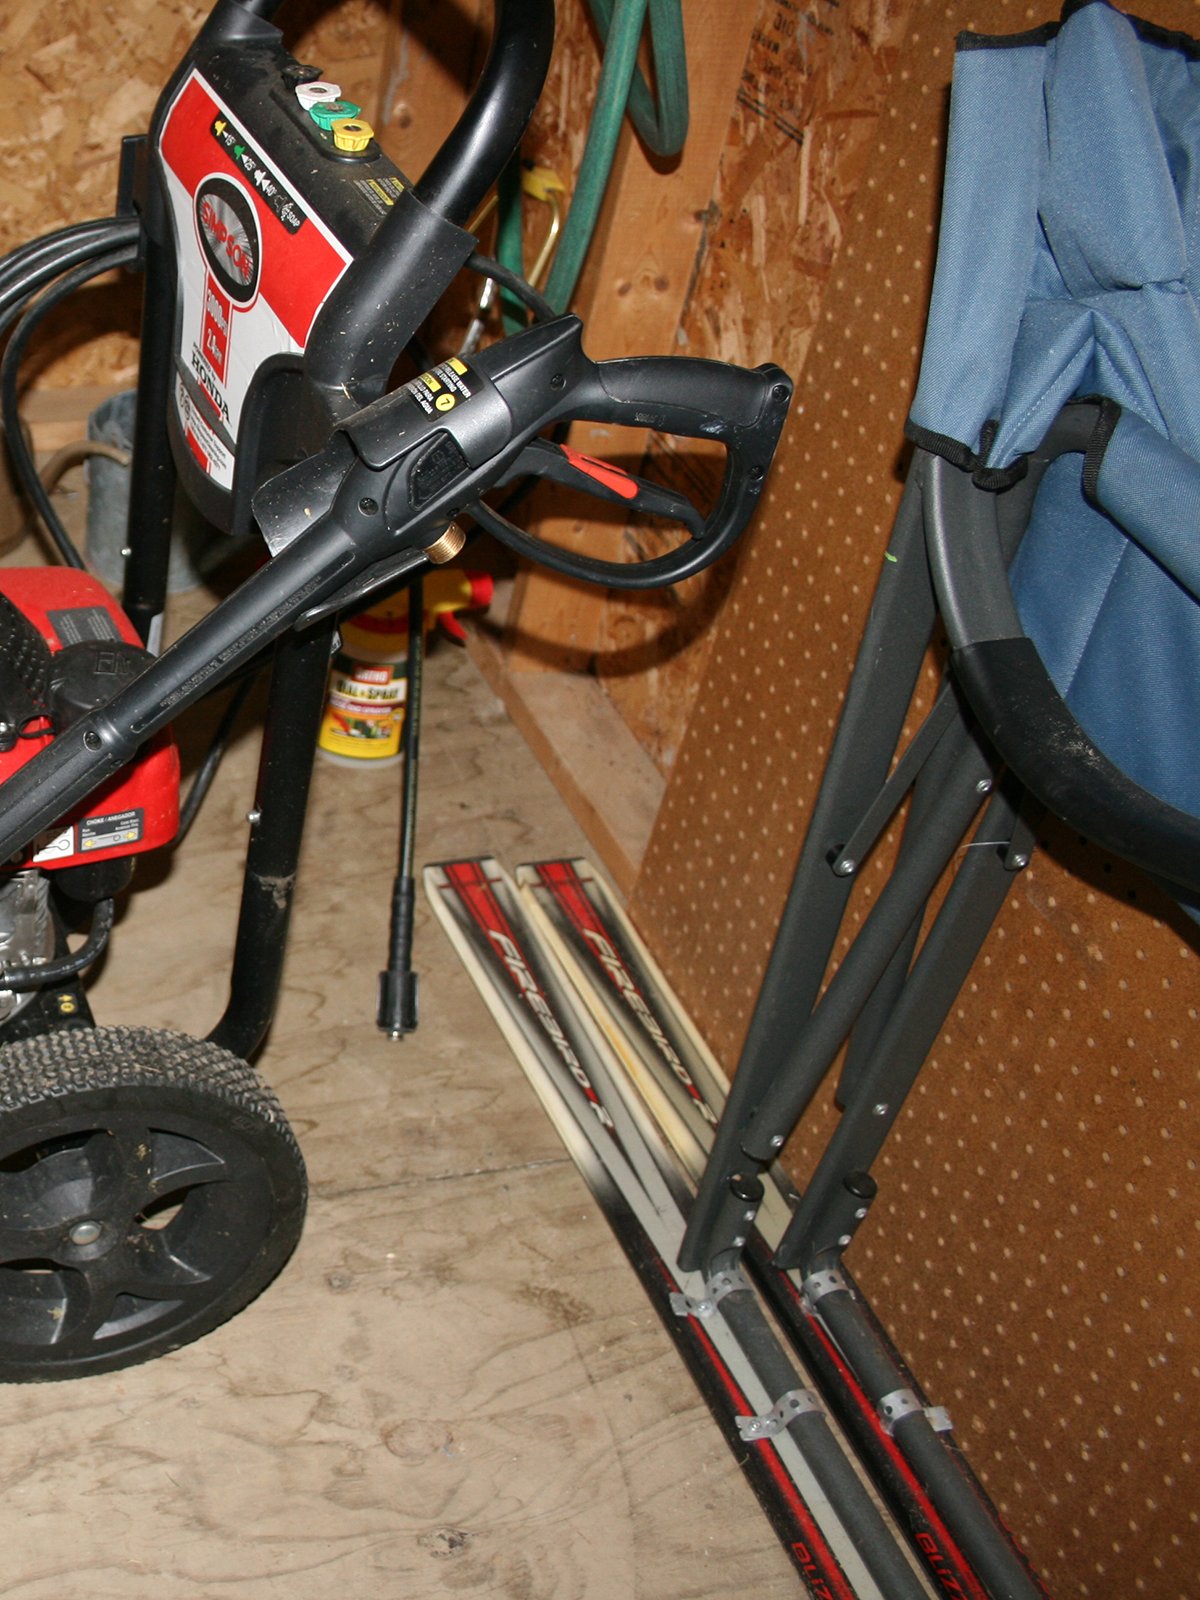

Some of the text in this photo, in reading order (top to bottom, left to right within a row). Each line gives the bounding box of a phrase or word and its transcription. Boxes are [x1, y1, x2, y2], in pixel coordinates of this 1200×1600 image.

[201, 202, 250, 281] SIMPSON
[192, 350, 231, 425] HONDA
[455, 380, 472, 399] WATER
[488, 929, 591, 1089] FIREBIRD
[583, 928, 693, 1087] FIREBIRD
